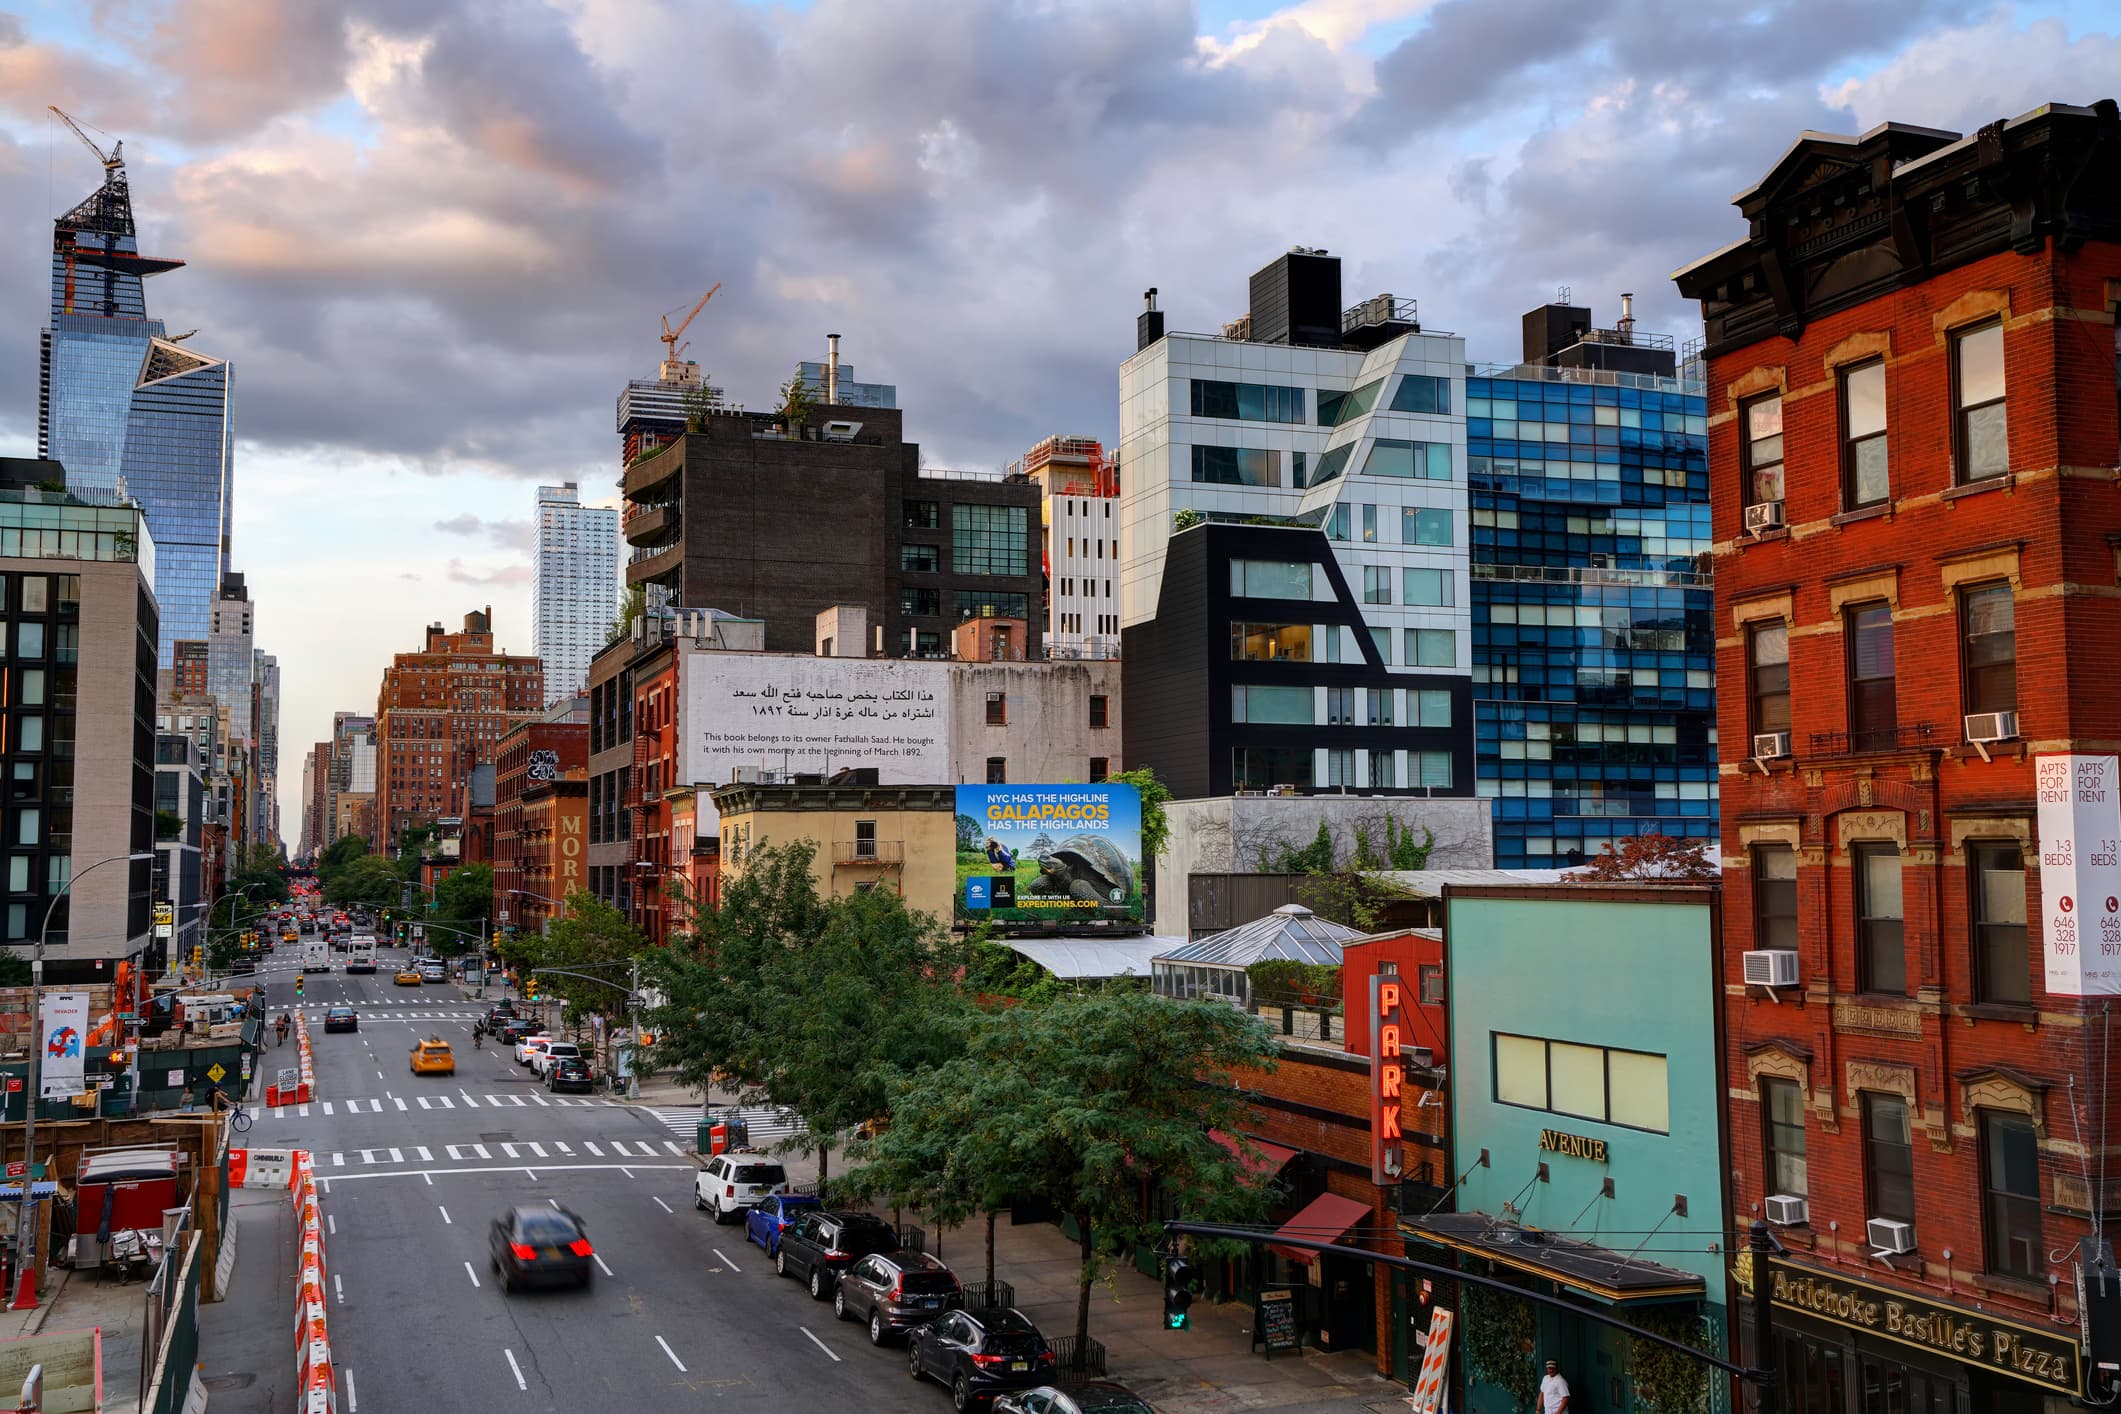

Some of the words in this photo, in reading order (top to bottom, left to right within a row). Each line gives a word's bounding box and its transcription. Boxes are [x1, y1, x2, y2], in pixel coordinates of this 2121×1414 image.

[732, 689, 757, 697] سعد
[782, 688, 801, 703] فتح
[806, 688, 843, 702] صاحبه
[848, 689, 878, 703] يخص
[882, 689, 914, 704] الكتاب
[917, 689, 934, 701] هذا
[787, 705, 809, 717] سنة
[835, 707, 854, 720] غرة
[858, 706, 878, 717] ماله
[882, 709, 898, 720] من
[902, 707, 934, 721] اشتراه
[704, 732, 722, 741] This
[723, 733, 746, 742] book
[747, 733, 779, 744] belongs
[781, 734, 791, 742] to
[793, 734, 803, 742] its
[805, 735, 832, 743] owner
[834, 734, 869, 744] Fathallah
[892, 736, 905, 745] He
[907, 736, 934, 747] bought
[703, 745, 709, 753] it
[711, 745, 730, 754] with
[733, 745, 745, 754] his
[767, 747, 795, 757] money
[797, 747, 806, 755] at
[808, 747, 822, 755] the
[824, 747, 862, 757] beginning
[863, 747, 872, 755] of
[874, 747, 899, 756] March
[2039, 762, 2067, 776] APTS
[2077, 762, 2105, 776] APTS
[2040, 776, 2064, 789] FOR
[2078, 776, 2101, 789] FOR
[987, 794, 1010, 803] NYC
[1012, 794, 1034, 803] HAS
[1036, 794, 1057, 803] THE
[1059, 793, 1109, 802] HIGHLINE
[2040, 790, 2069, 803] RENT
[2078, 790, 2106, 803] RENT
[987, 820, 1012, 830] HAS
[1014, 820, 1037, 830] THE
[1040, 820, 1109, 830] HIGHLANDS
[2055, 839, 2072, 852] 1-3
[2101, 839, 2117, 852] 1-3
[2044, 853, 2073, 866] BEDS
[2090, 853, 2118, 866] BEDS
[1017, 900, 1098, 908] EXPEDITIONS.COM
[2053, 916, 2075, 929] 646
[2100, 916, 2121, 929] 646
[2055, 929, 2076, 942] 328
[2102, 929, 2121, 943] 328
[2053, 943, 2076, 956] 1917
[2099, 943, 2121, 956] 1917
[1380, 984, 1401, 1140] PARK
[1539, 1129, 1606, 1162] AVENUE
[1773, 1270, 1879, 1326] Artichoke
[1885, 1301, 1985, 1358] Basille's
[1993, 1329, 2071, 1384] Pizza
